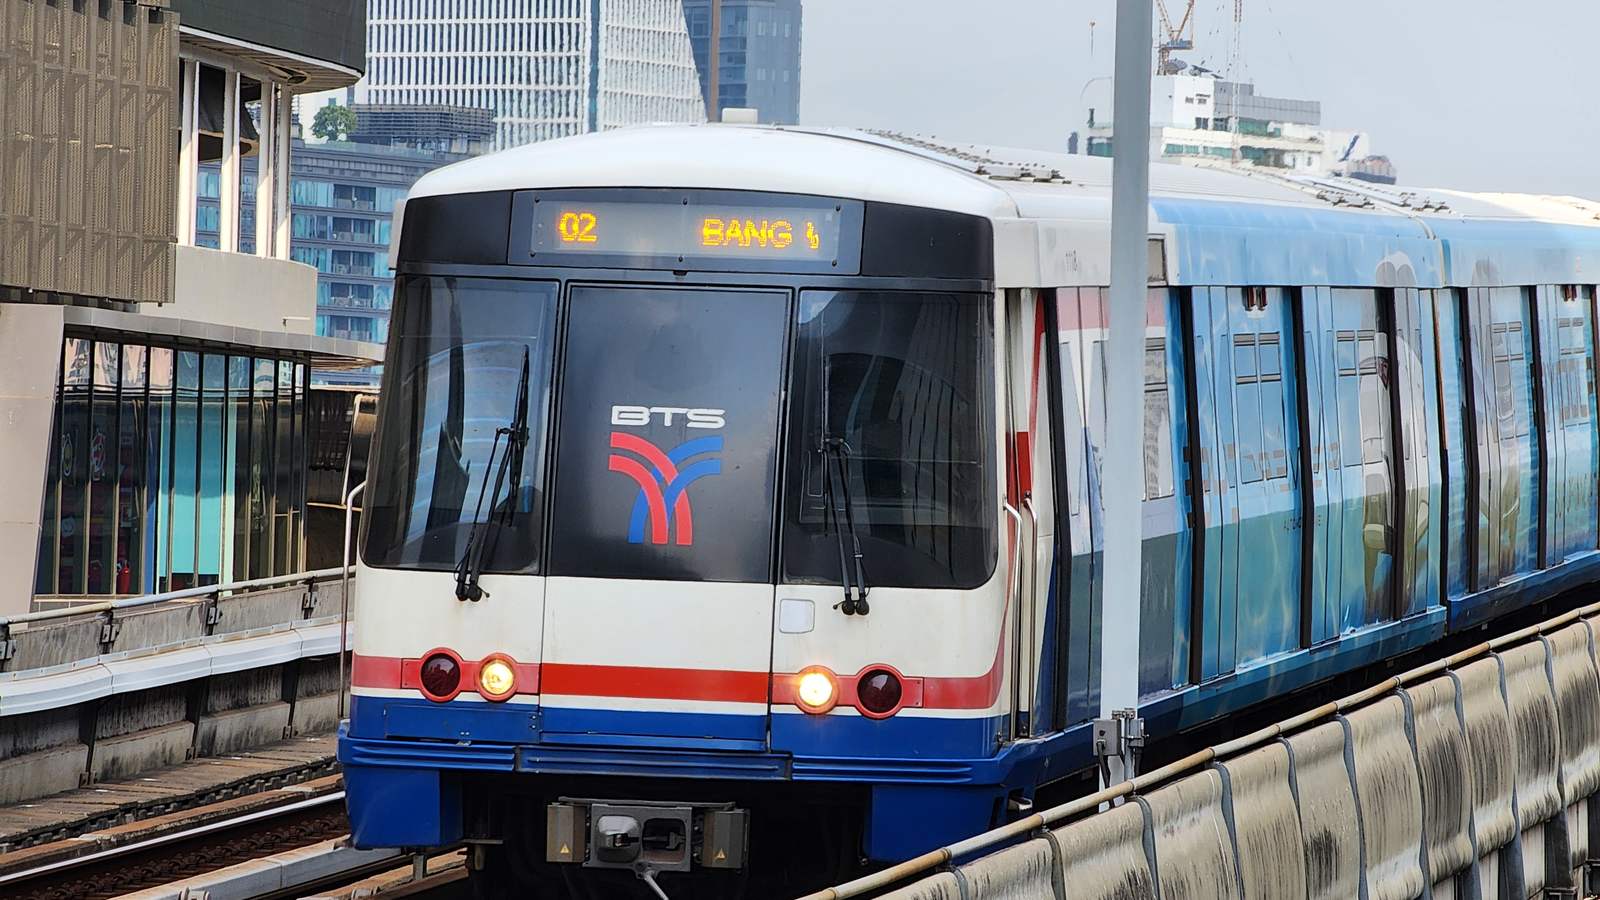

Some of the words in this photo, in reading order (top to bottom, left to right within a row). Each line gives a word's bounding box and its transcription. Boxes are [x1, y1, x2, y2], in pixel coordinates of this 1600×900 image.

[559, 212, 598, 242] 02
[702, 218, 792, 248] BANG
[611, 405, 726, 429] BTS
